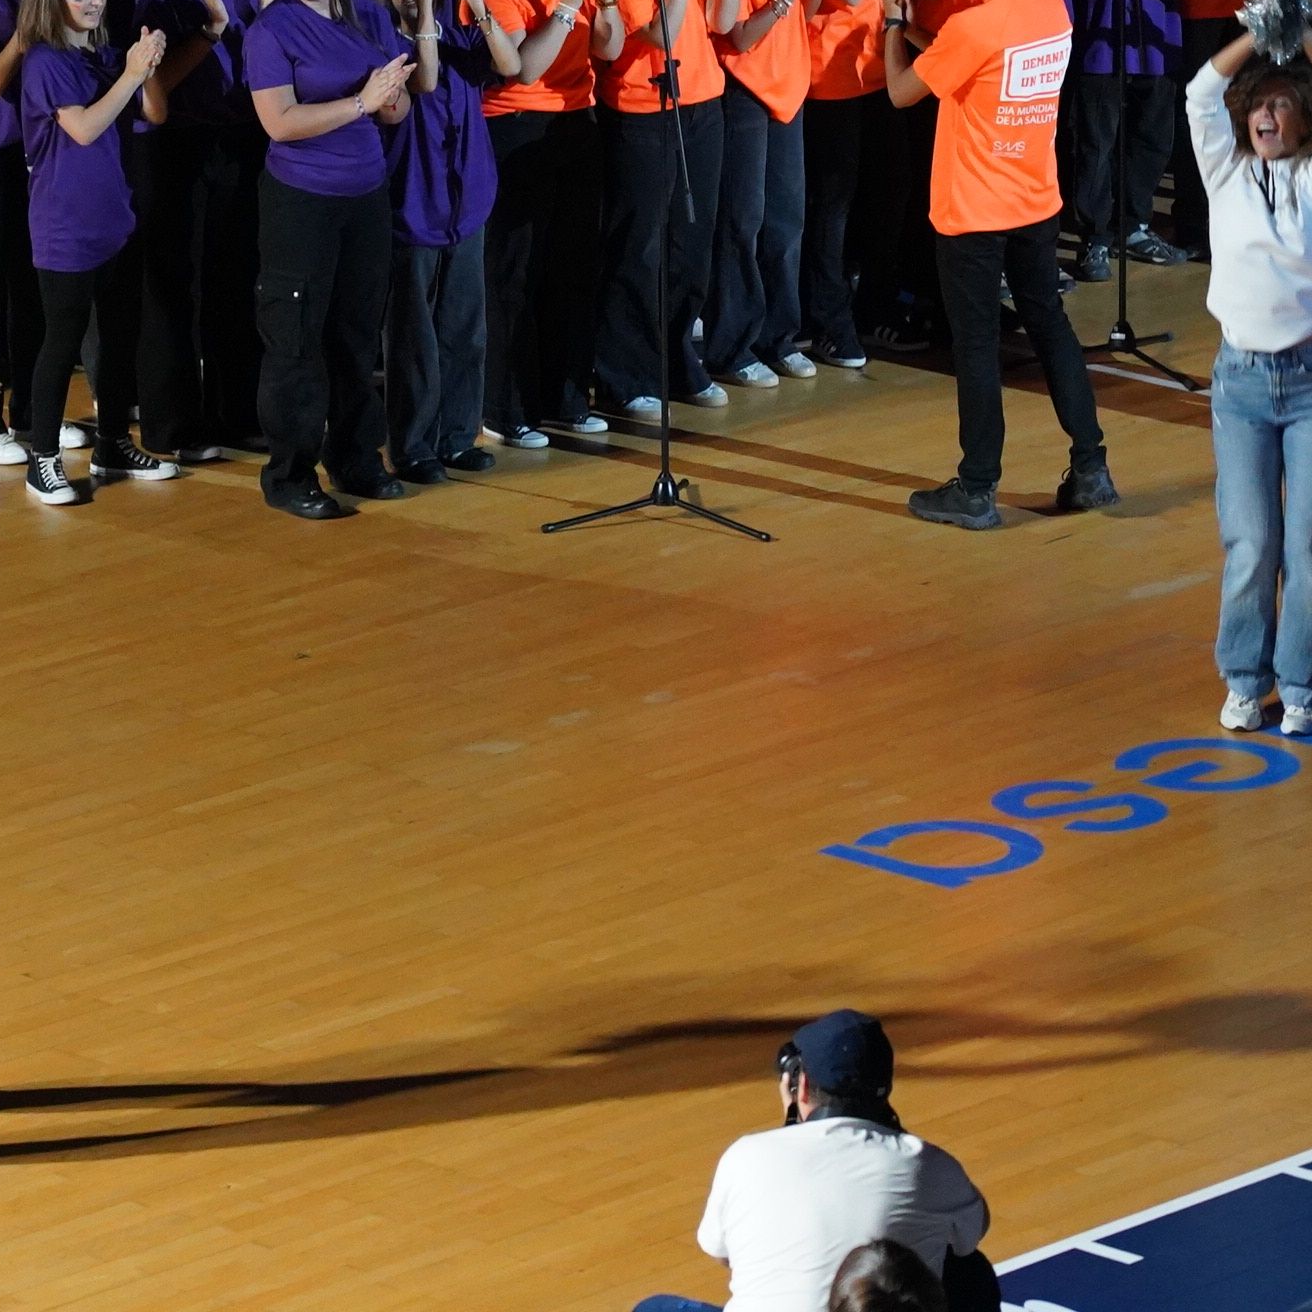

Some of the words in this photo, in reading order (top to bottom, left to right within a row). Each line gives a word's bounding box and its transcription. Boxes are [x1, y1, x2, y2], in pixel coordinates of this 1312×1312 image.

[1021, 75, 1037, 87] UN
[997, 105, 1015, 115] DIA
[1016, 103, 1056, 116] MUNDIAL
[995, 115, 1009, 125] DE
[1011, 116, 1023, 126] LA
[1025, 114, 1053, 125] SALUT
